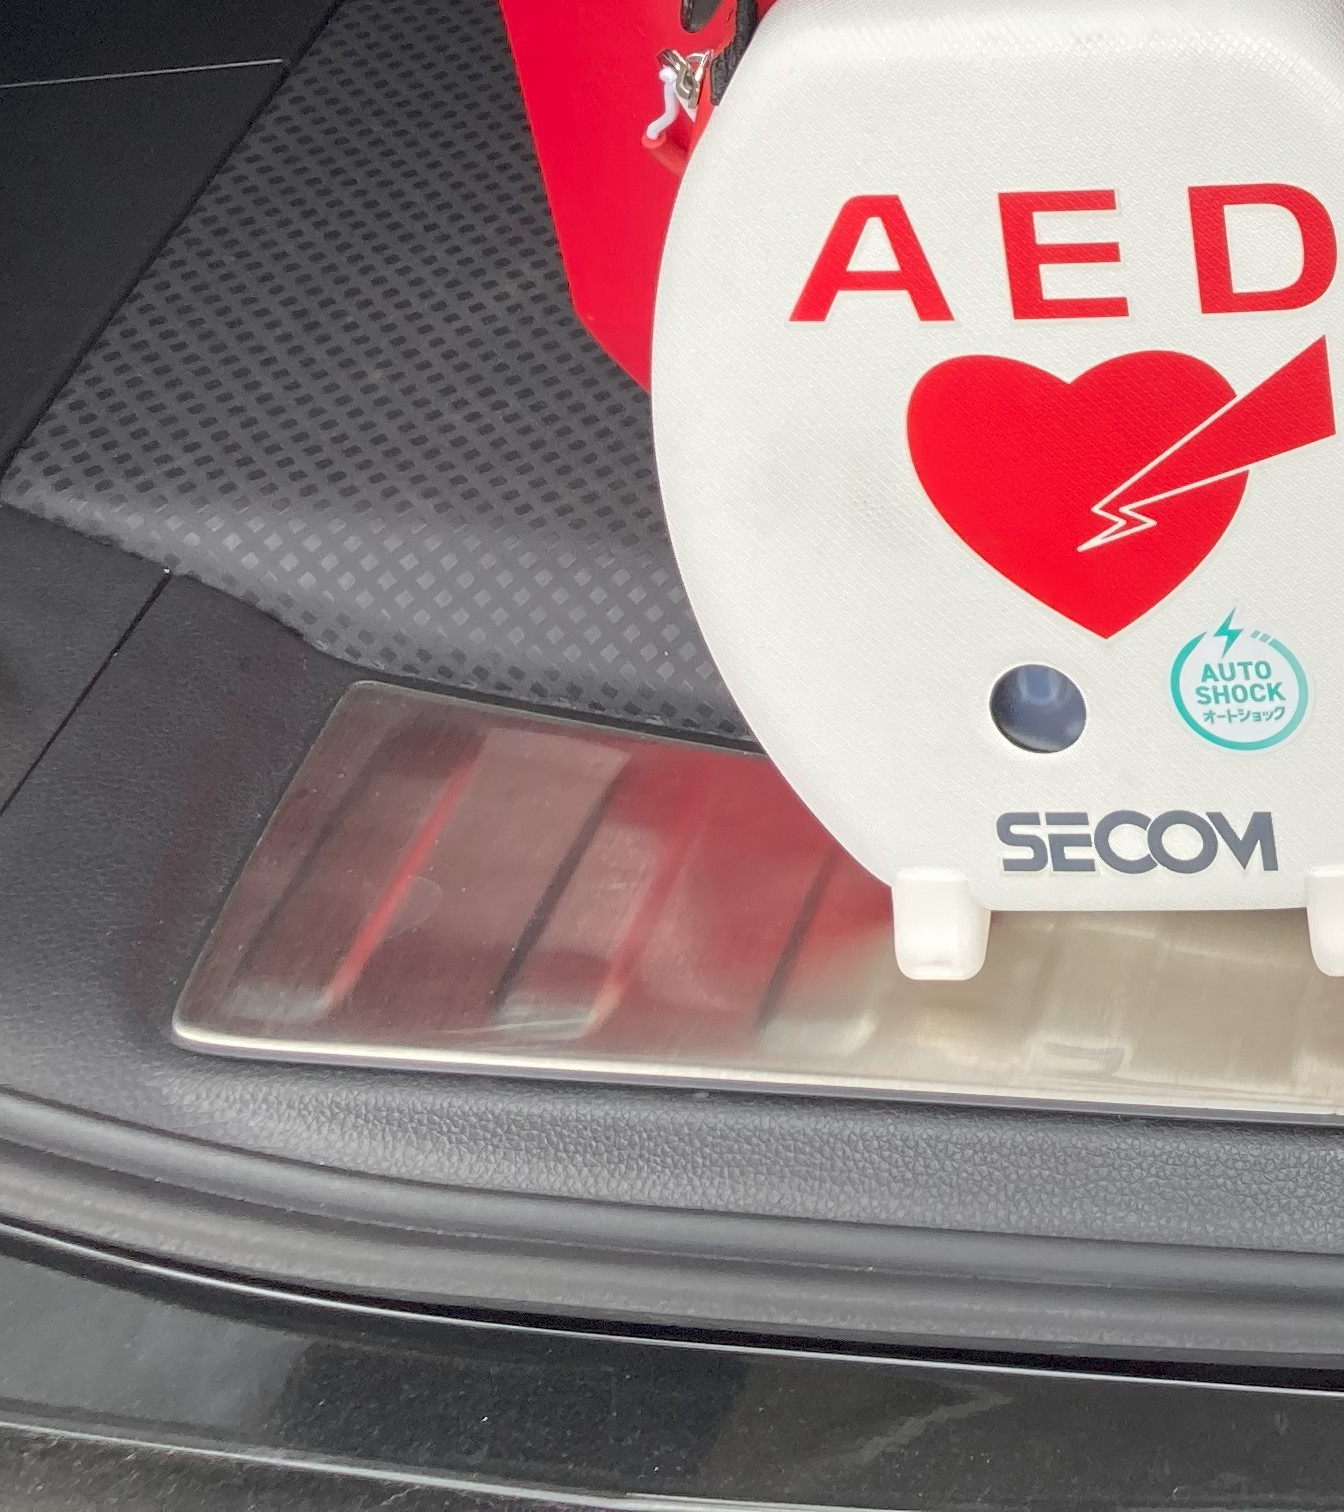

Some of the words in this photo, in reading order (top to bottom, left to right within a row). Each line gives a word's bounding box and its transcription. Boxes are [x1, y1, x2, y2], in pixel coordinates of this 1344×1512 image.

[788, 182, 1338, 322] AED
[1201, 660, 1272, 683] AUTO
[1195, 681, 1287, 705] SHOCK
[1203, 706, 1286, 724] オートショック
[996, 809, 1279, 875] SECOM
